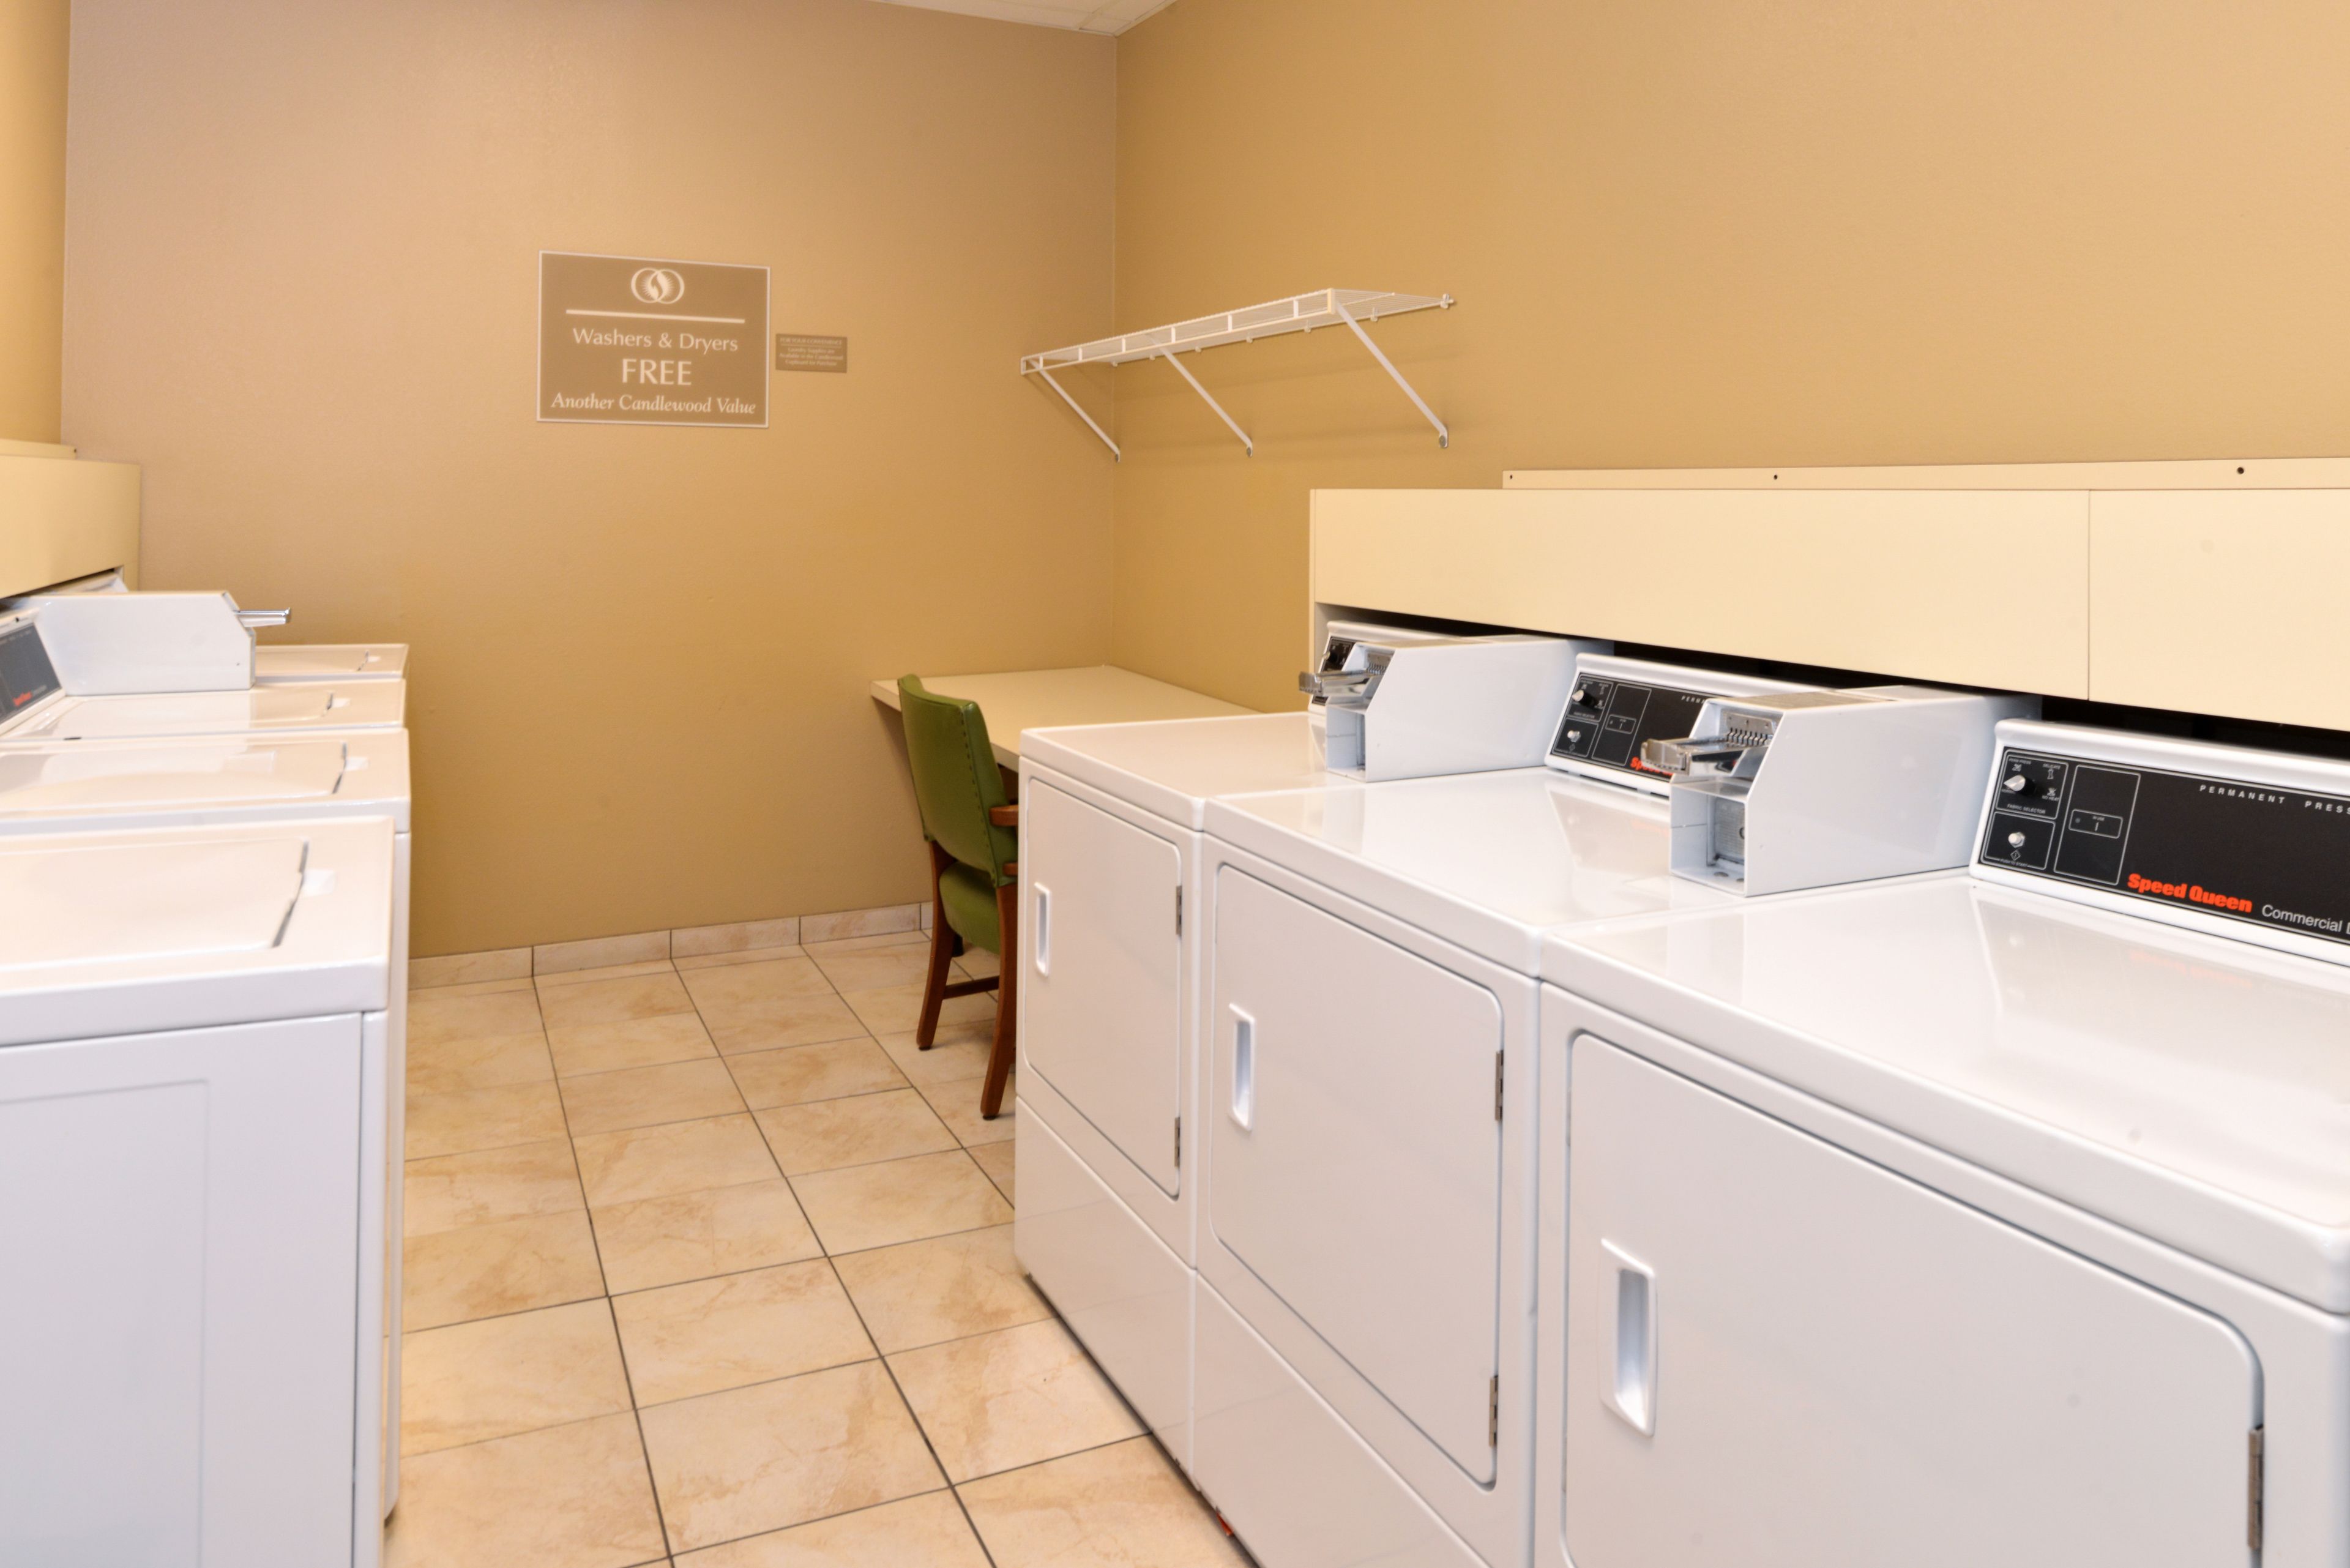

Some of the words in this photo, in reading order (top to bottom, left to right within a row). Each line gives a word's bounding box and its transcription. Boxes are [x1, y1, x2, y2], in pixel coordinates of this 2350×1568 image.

[573, 327, 652, 348] Washers
[658, 332, 672, 348] &
[679, 332, 738, 355] Dryers
[622, 358, 692, 386] FREE
[551, 392, 614, 409] Another
[619, 394, 712, 413] Candlewood
[717, 397, 756, 414] Value
[2199, 785, 2286, 804] PERMANENT
[2127, 873, 2188, 898] Speed
[2189, 886, 2253, 913] Queen
[2262, 904, 2343, 933] Commercial
